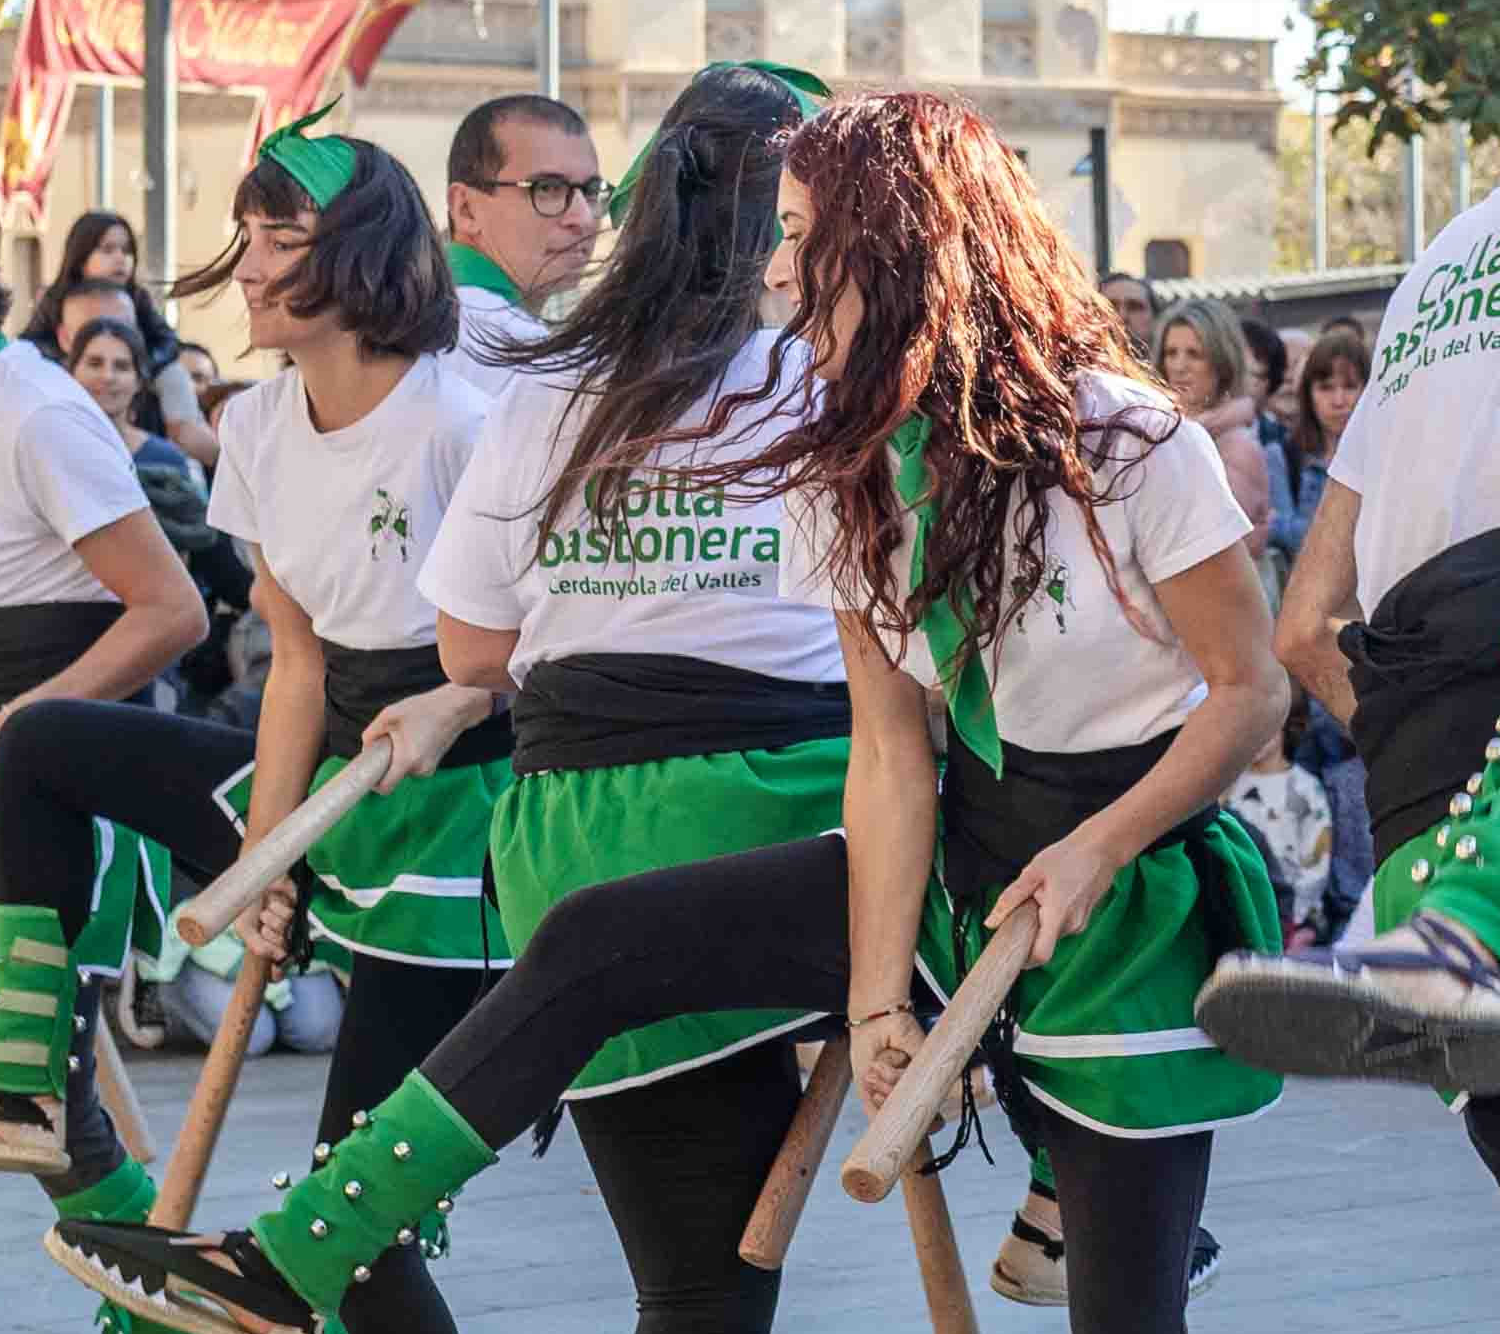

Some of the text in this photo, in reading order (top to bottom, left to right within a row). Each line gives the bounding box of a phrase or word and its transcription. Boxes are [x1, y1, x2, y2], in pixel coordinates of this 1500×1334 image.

[1444, 333, 1471, 359] del
[661, 572, 688, 592] del
[695, 571, 762, 590] Vallès
